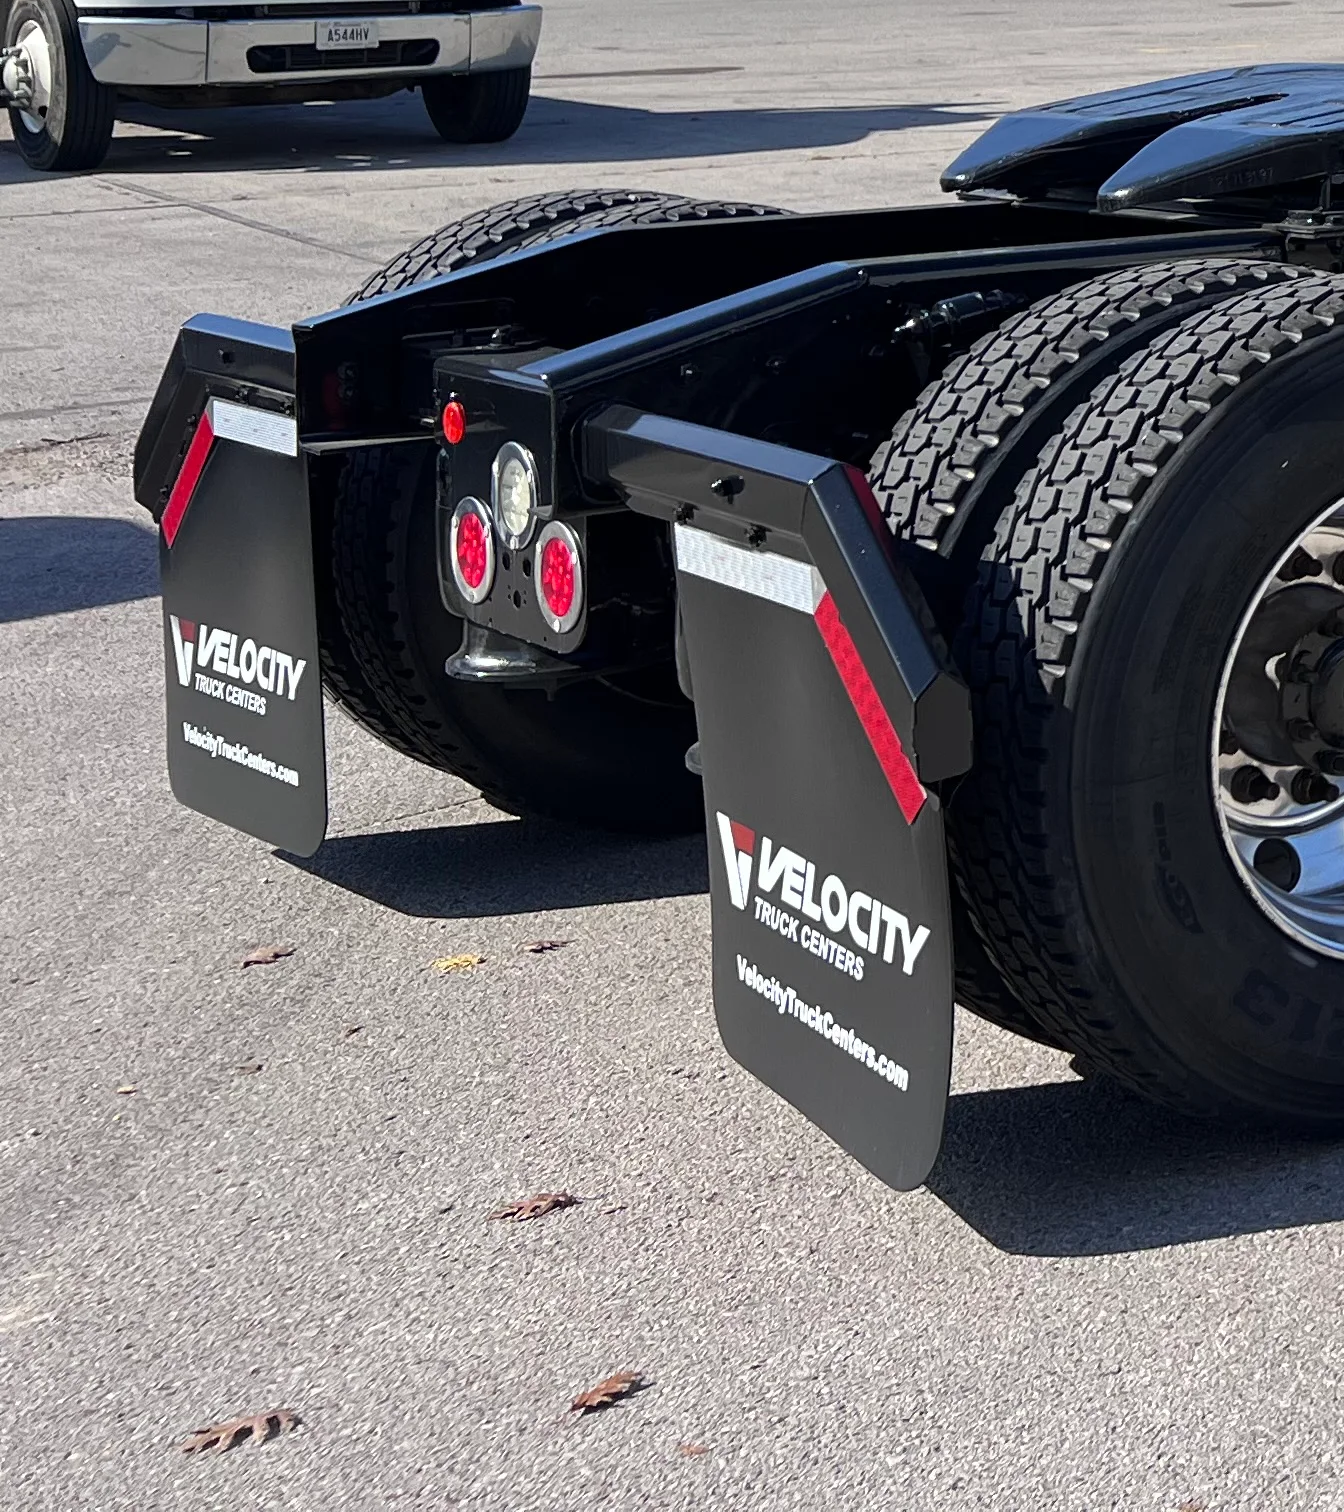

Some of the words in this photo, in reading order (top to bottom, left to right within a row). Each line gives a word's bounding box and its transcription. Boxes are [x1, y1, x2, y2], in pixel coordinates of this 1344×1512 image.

[327, 27, 370, 42] A544HV
[194, 672, 225, 701] TRUCK
[225, 683, 267, 716] CENTERS
[196, 623, 307, 701] VELOCITY
[182, 721, 300, 788] VelocityTruckCenters.com
[754, 896, 798, 943] TRUCK
[800, 924, 865, 981] CENTERS
[757, 836, 932, 977] VELOCITY
[736, 953, 909, 1092] VelocityTruckCenters.com
